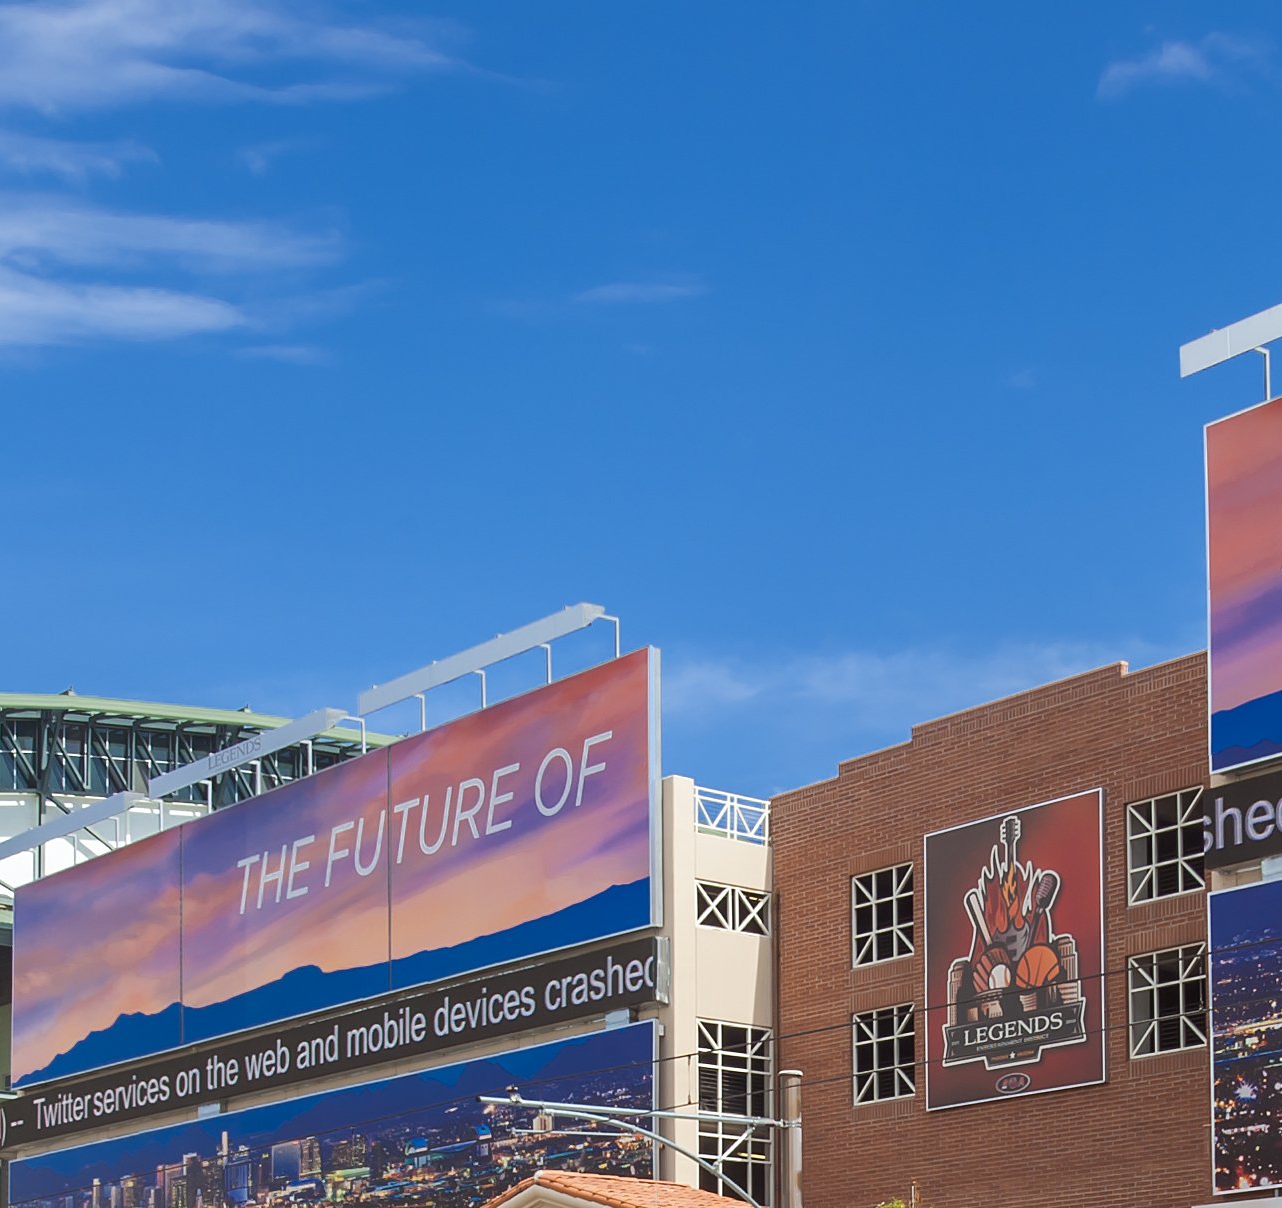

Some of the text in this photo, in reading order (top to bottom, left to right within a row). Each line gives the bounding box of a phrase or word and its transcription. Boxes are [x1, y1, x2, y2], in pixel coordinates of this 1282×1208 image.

[208, 738, 262, 770] LEGENDS
[237, 730, 613, 915] THE FUTURE OF
[33, 1092, 92, 1130] Twitter
[93, 1074, 170, 1113] services
[175, 1068, 200, 1097] on
[206, 1055, 239, 1090] the
[245, 1039, 290, 1081] web
[296, 1025, 339, 1070] and
[346, 1007, 426, 1058] mobile
[433, 986, 536, 1037] devices
[963, 1012, 1063, 1046] LEGENDS
